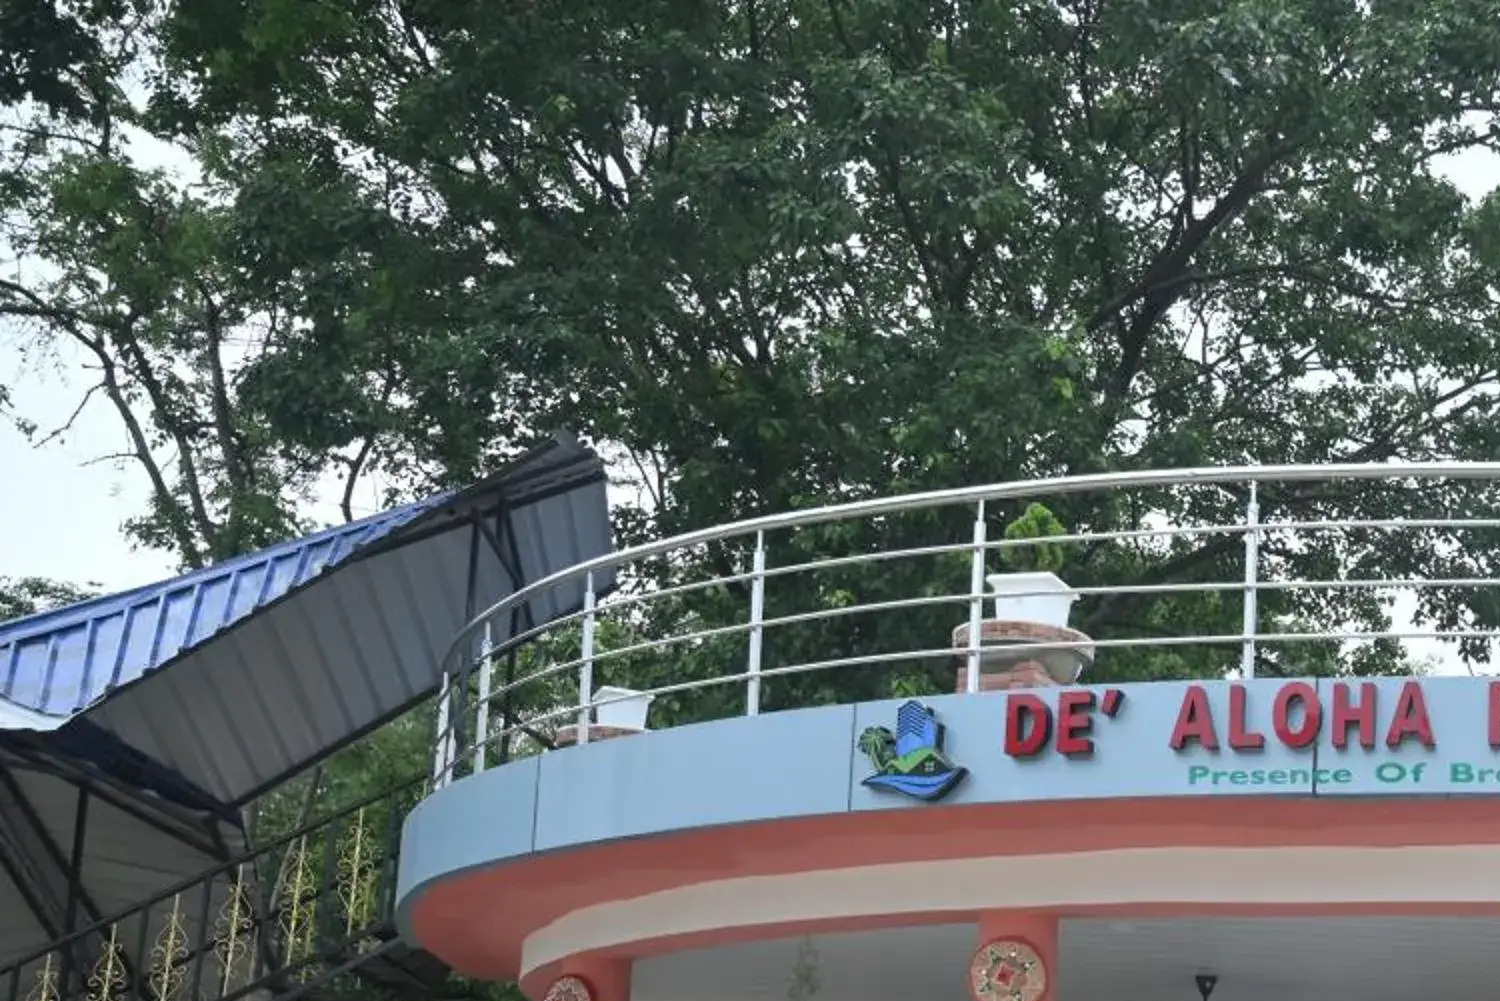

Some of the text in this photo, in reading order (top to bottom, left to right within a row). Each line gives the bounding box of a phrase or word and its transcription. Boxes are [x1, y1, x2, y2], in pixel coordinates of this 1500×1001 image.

[1169, 680, 1437, 752] ALOHA
[1188, 765, 1353, 786] Presence
[1375, 761, 1428, 785] Of
